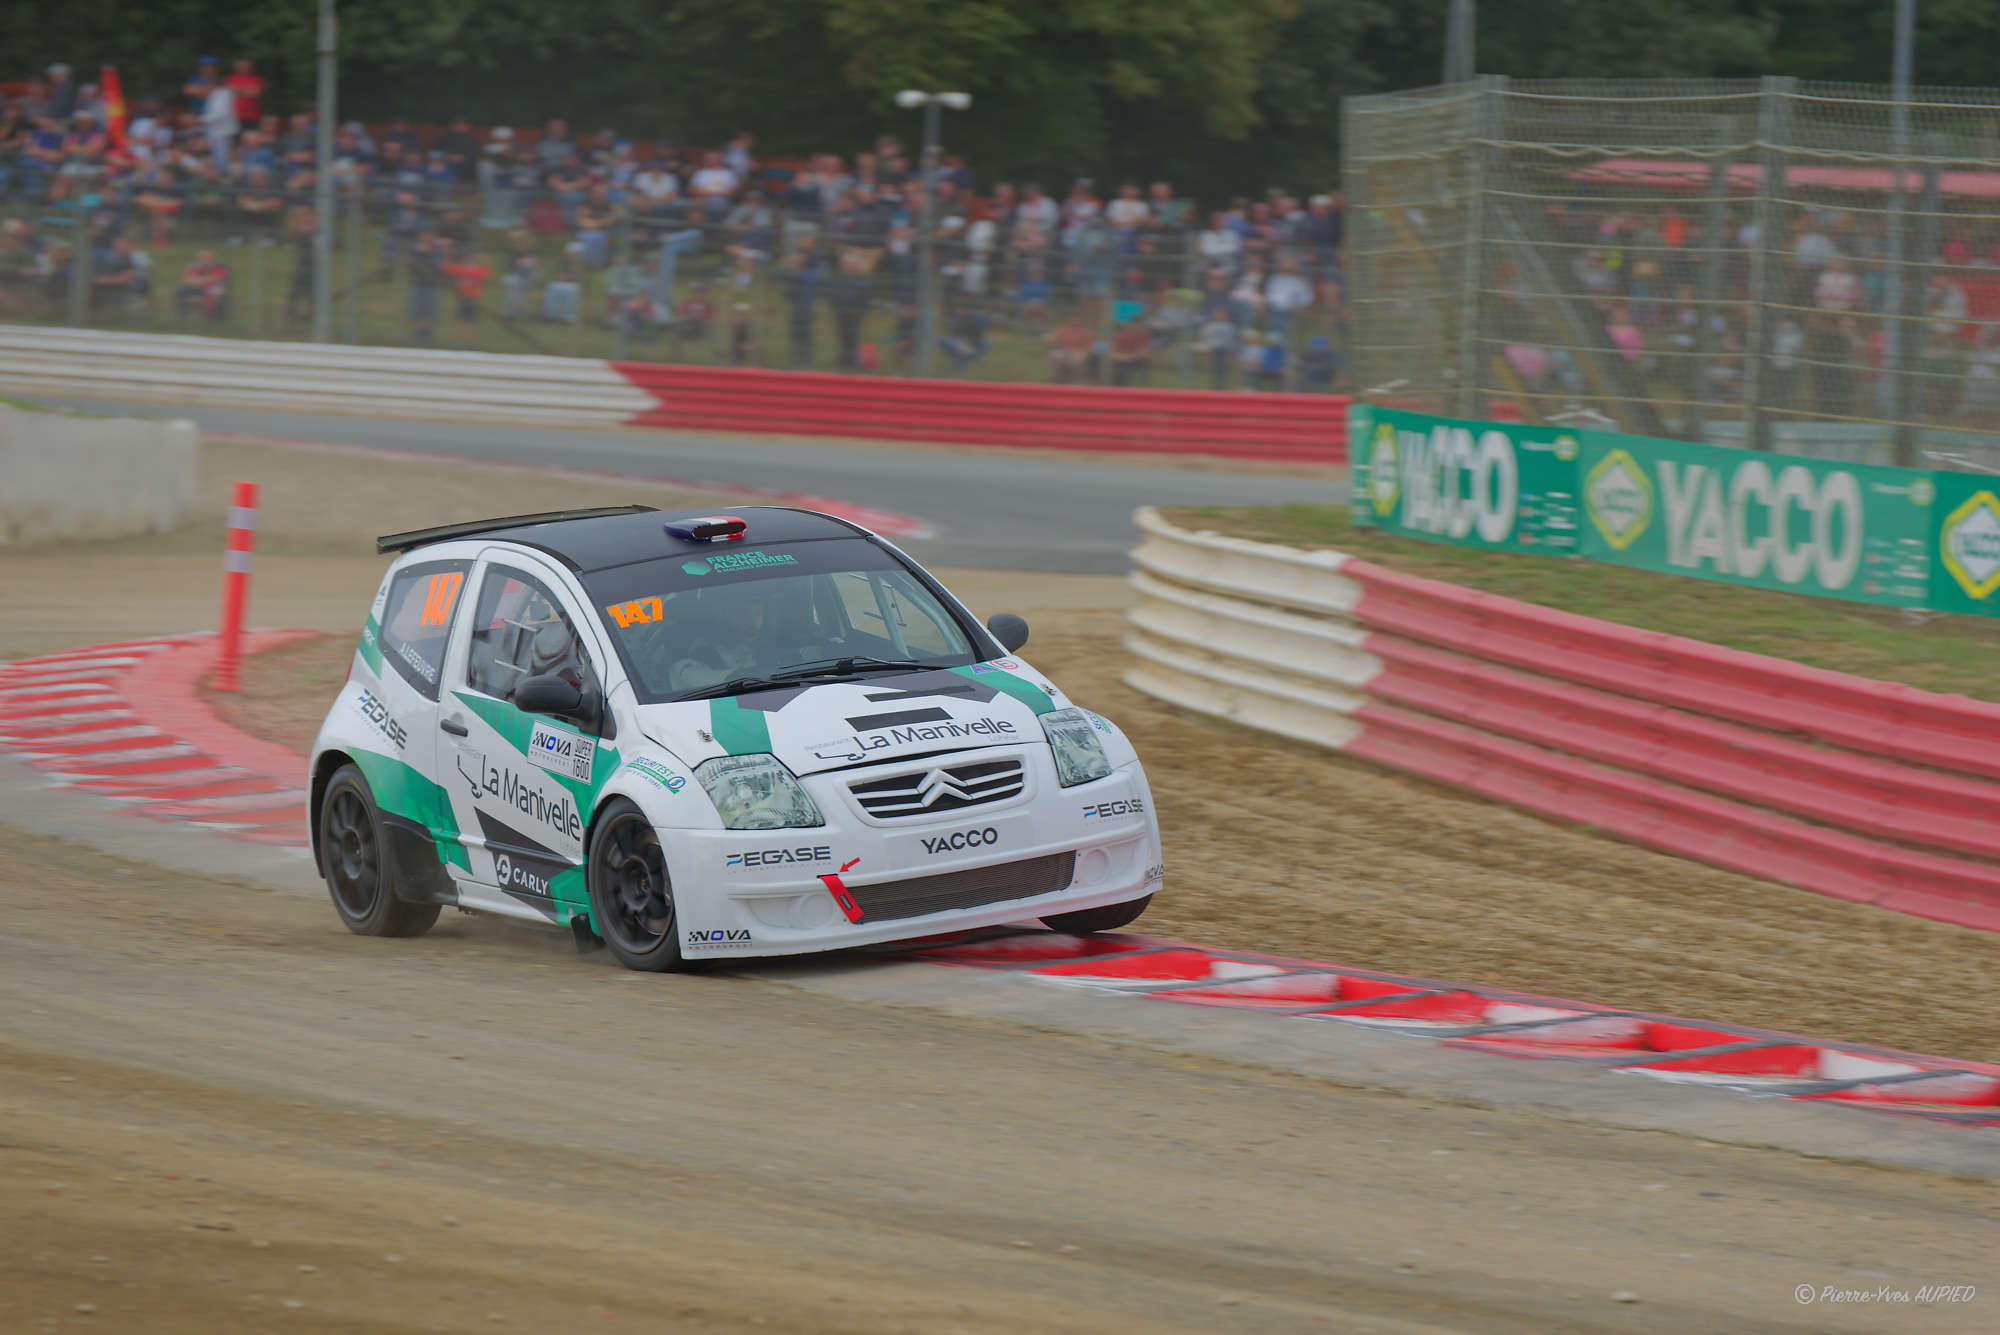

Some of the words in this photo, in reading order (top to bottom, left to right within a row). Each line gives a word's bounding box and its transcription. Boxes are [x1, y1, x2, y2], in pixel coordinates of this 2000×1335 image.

[1653, 460, 1864, 590] YACCO
[706, 552, 765, 563] FRANCE
[714, 555, 794, 569] ALZHEIMER
[419, 573, 463, 626] 147
[608, 598, 663, 628] 147
[358, 689, 407, 750] PEGASE
[533, 731, 571, 757] NOVA
[853, 735, 890, 752] La
[890, 717, 1017, 746] Manivelle
[572, 758, 590, 780] 1600
[481, 754, 499, 796] La
[503, 767, 581, 842] Manivelle
[1082, 799, 1144, 818] PEGASE
[921, 827, 998, 855] YACCO
[726, 845, 831, 867] PEGASE
[513, 867, 549, 895] CARLY
[690, 929, 752, 942] NOVA
